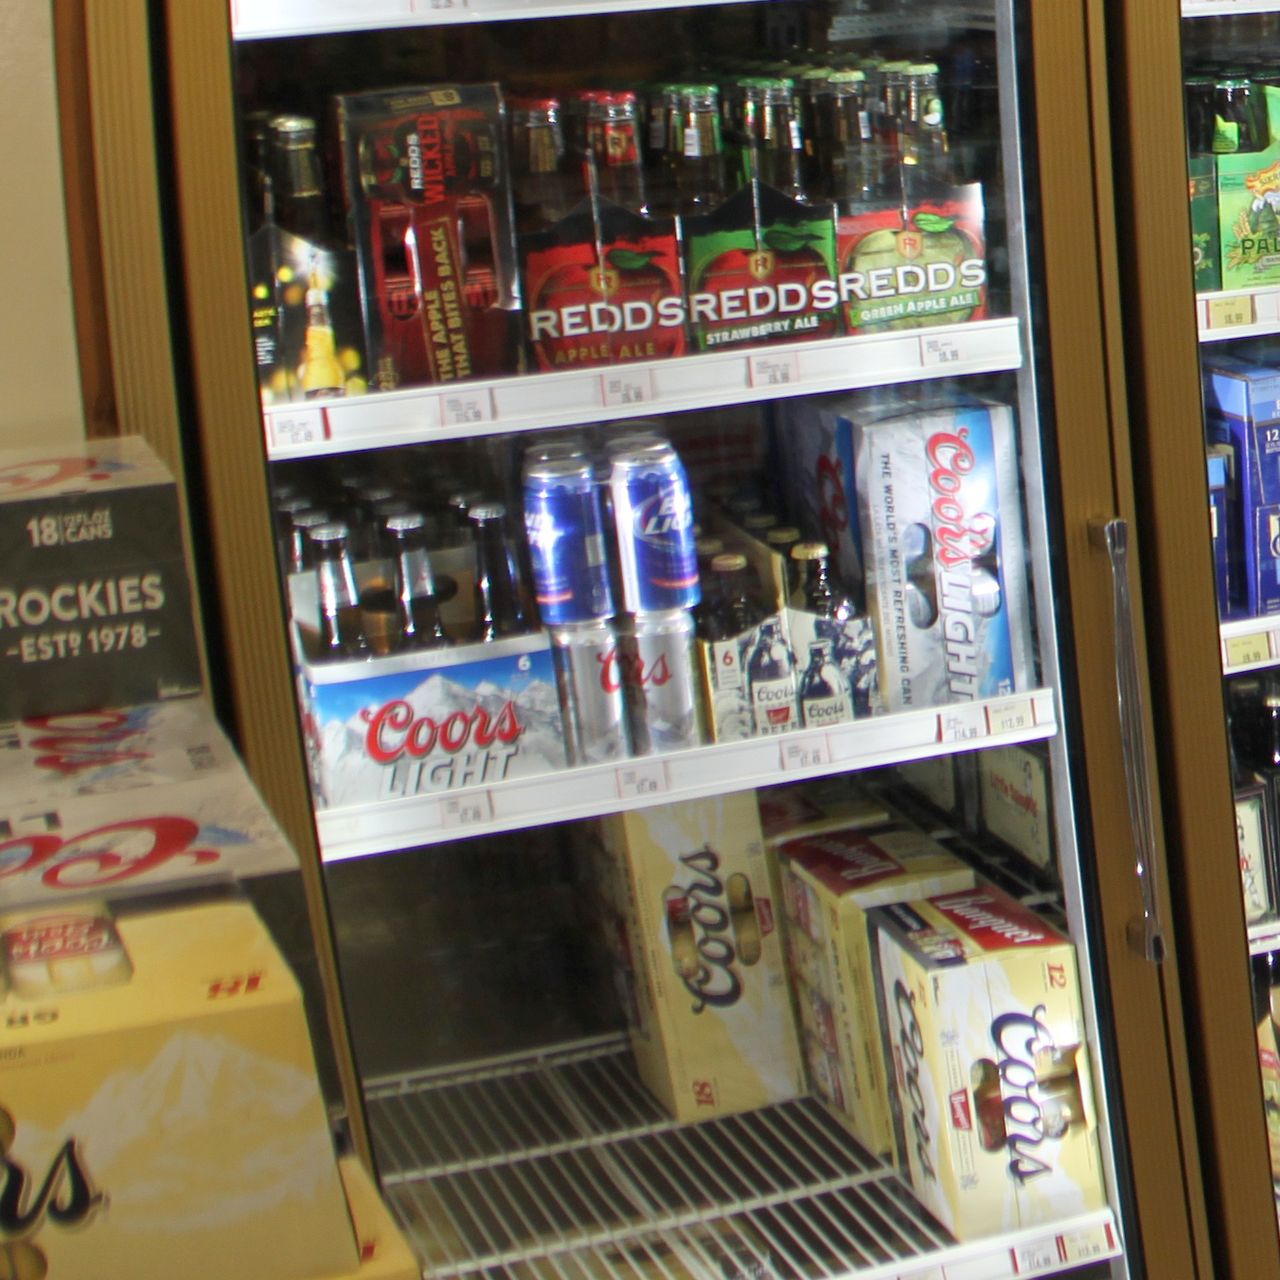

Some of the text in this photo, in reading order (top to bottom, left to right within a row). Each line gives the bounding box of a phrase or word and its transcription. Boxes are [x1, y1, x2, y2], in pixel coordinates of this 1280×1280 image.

[417, 113, 446, 206] WICKED
[430, 225, 451, 276] BACK
[860, 292, 975, 323] GREEN APPLE ALE
[705, 314, 819, 346] STRAWBERRY ALE
[555, 341, 657, 366] APPLE ALE
[1264, 428, 1280, 443] 12
[26, 516, 59, 548] 18
[66, 522, 113, 543] CANS
[880, 453, 913, 706] THE WORLD'S MOST REFRESHING CAN
[925, 428, 979, 702] Coors LIGHT
[0, 574, 165, 629] ROCKIES
[517, 653, 532, 672] 6
[721, 649, 734, 668] 6
[756, 682, 798, 705] Coors
[807, 699, 845, 720] Coors
[361, 698, 525, 765] Coors
[380, 745, 520, 801] LIGHT
[679, 841, 742, 1016] Coors
[1047, 962, 1067, 990] 12
[990, 1004, 1054, 1186] Coors
